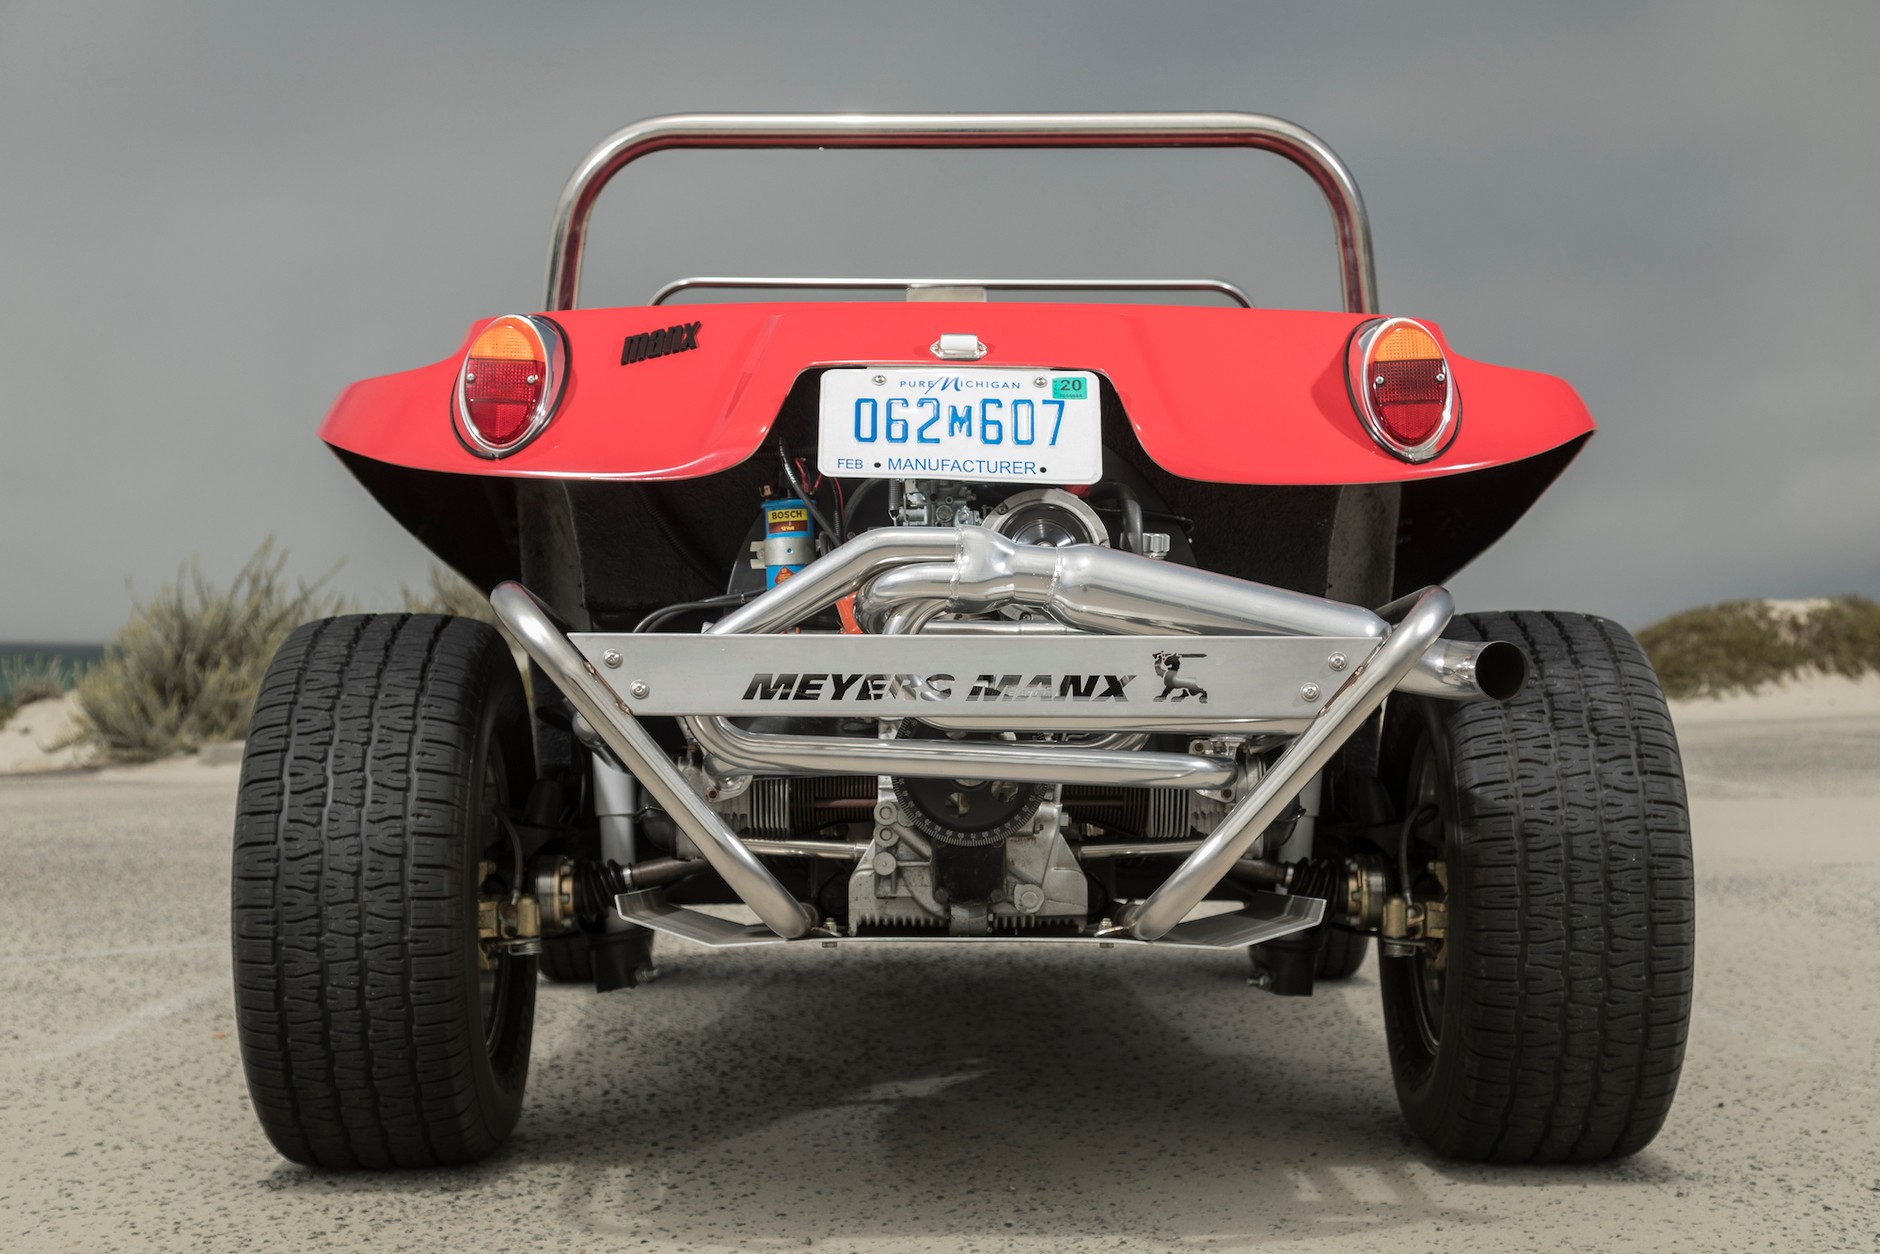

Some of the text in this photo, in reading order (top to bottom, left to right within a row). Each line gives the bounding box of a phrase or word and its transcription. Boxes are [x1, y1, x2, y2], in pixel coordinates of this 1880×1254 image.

[900, 376, 1021, 391] PURE MICHIGAN
[1060, 379, 1082, 391] 20
[854, 398, 1065, 446] 062M607
[837, 458, 863, 470] FEB
[888, 458, 1037, 475] MANUFACTURER
[771, 510, 802, 520] BOSCH
[741, 673, 1138, 702] MEYERS MANX
